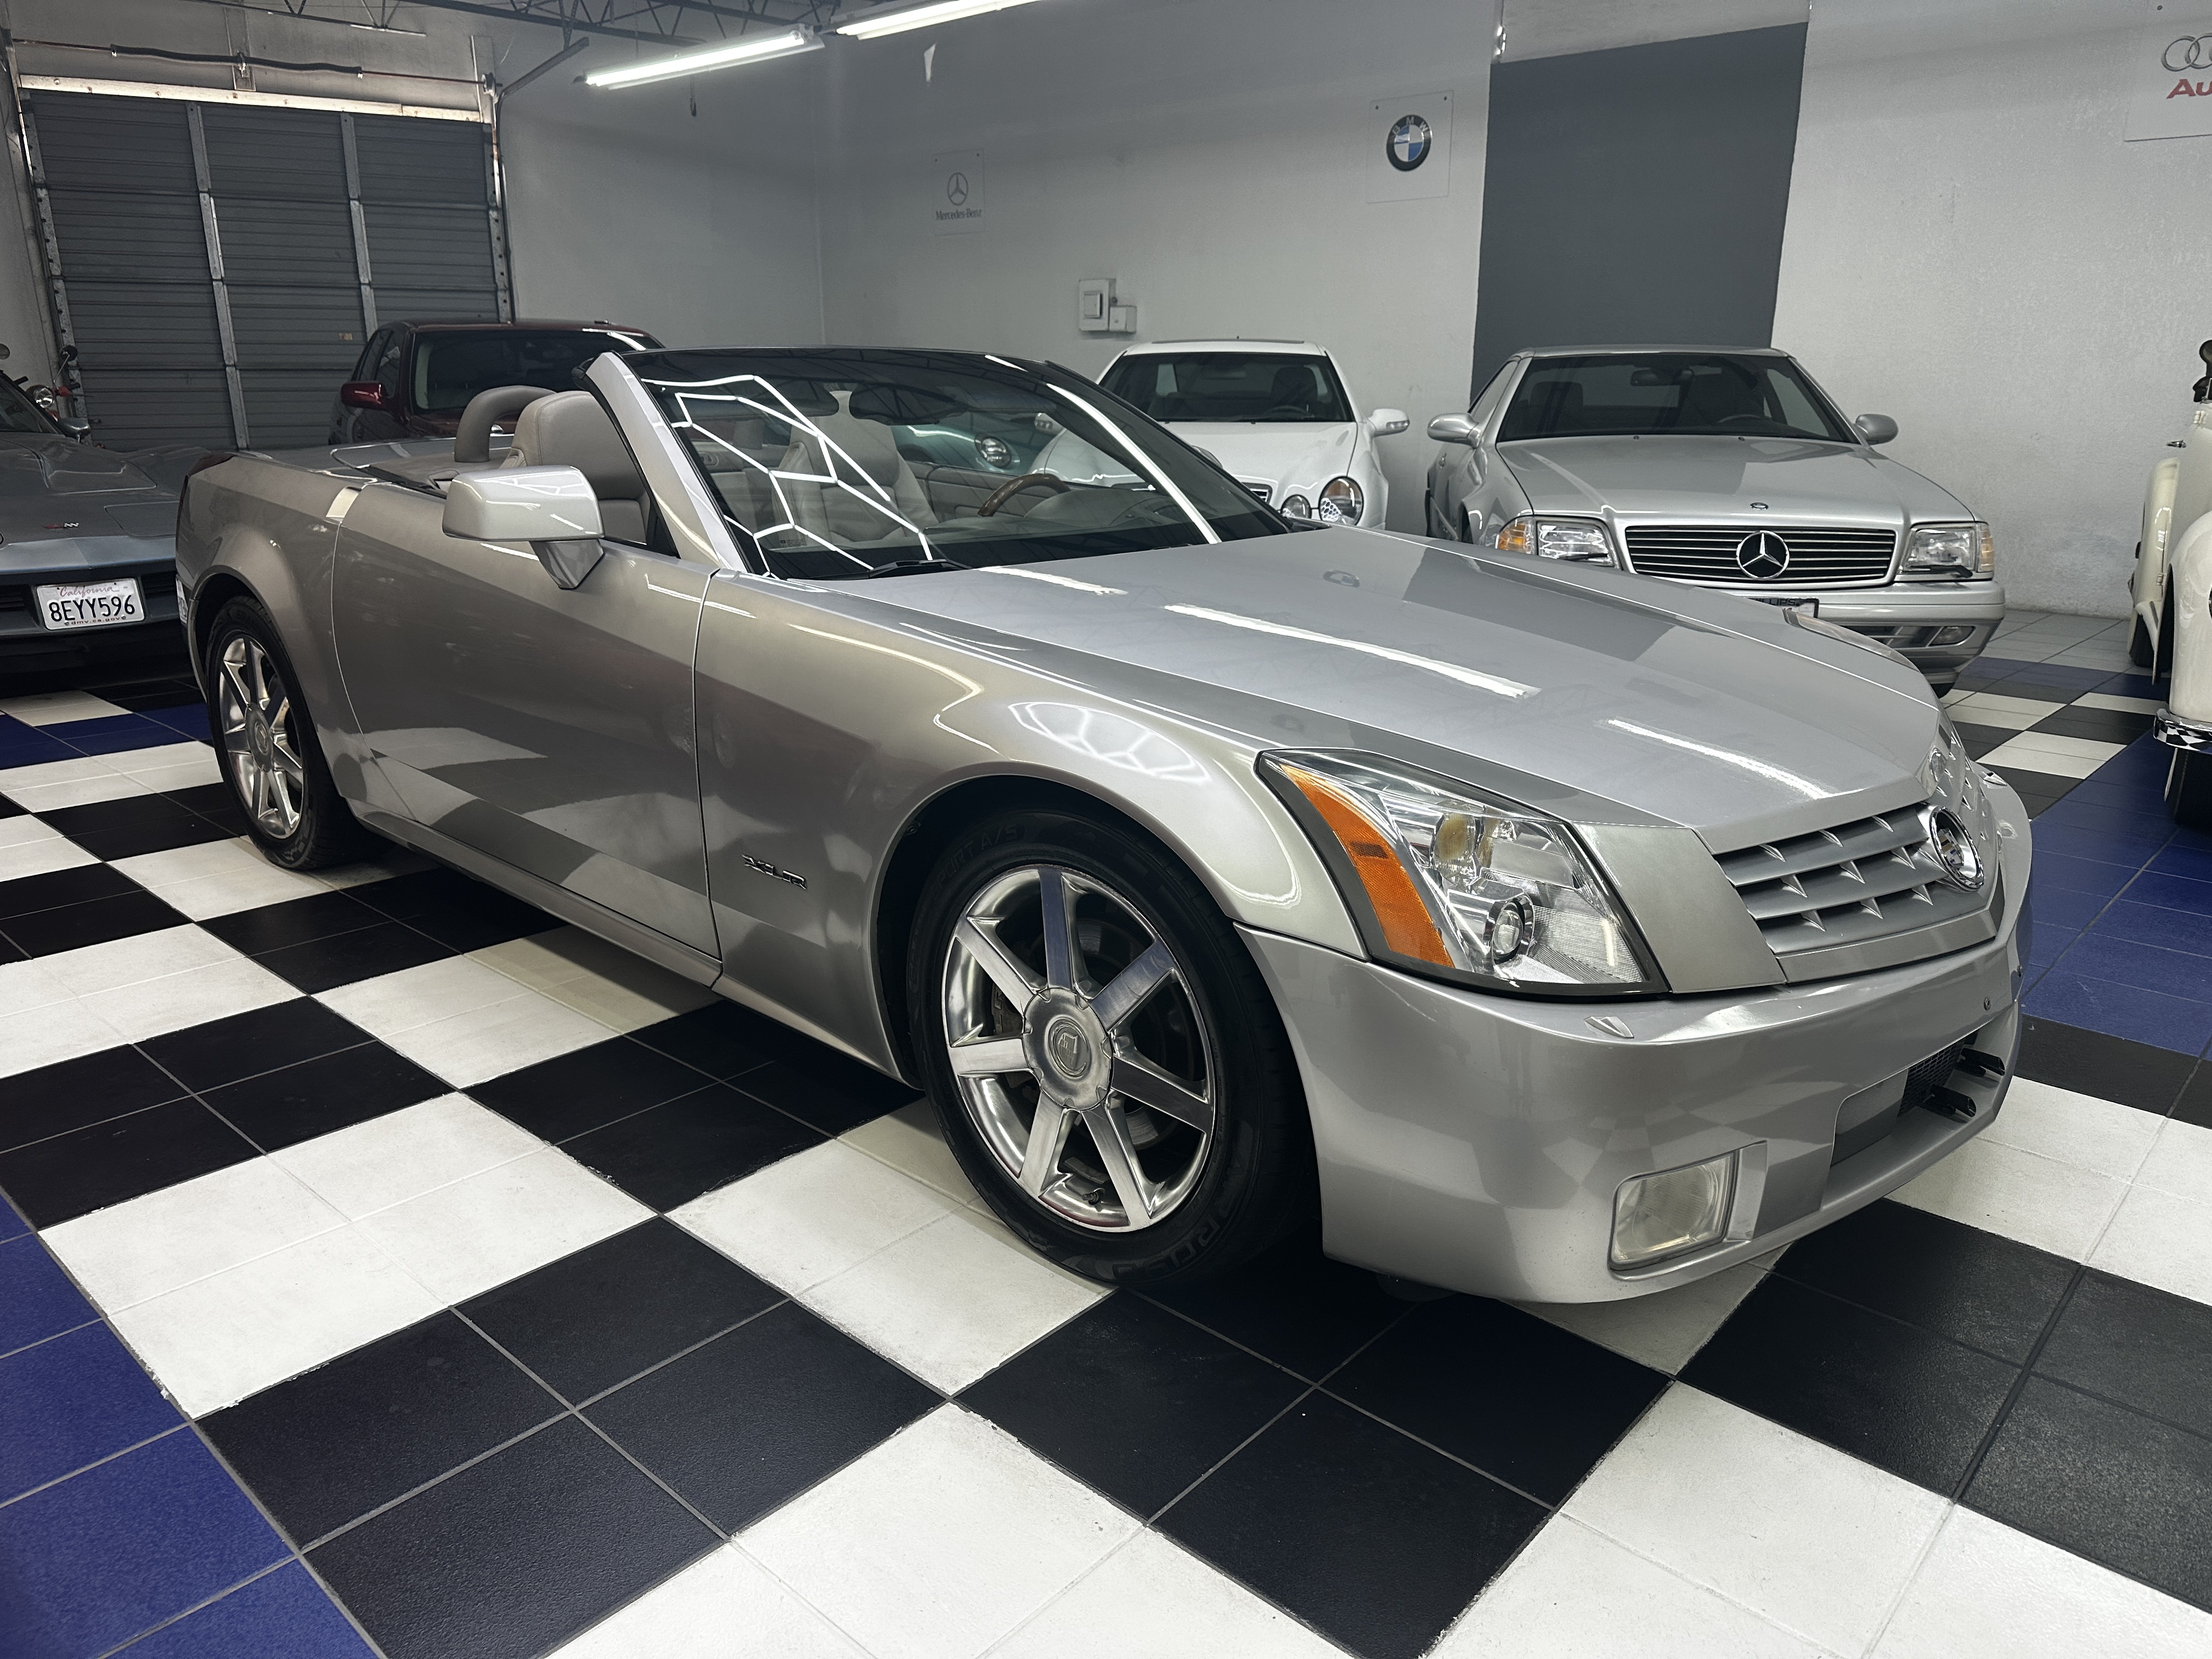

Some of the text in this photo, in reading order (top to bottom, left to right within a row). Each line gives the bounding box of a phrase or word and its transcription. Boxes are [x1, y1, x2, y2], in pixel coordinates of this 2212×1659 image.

[60, 586, 120, 598] California
[49, 595, 135, 622] 8EYY596
[979, 825, 1017, 851] A/S
